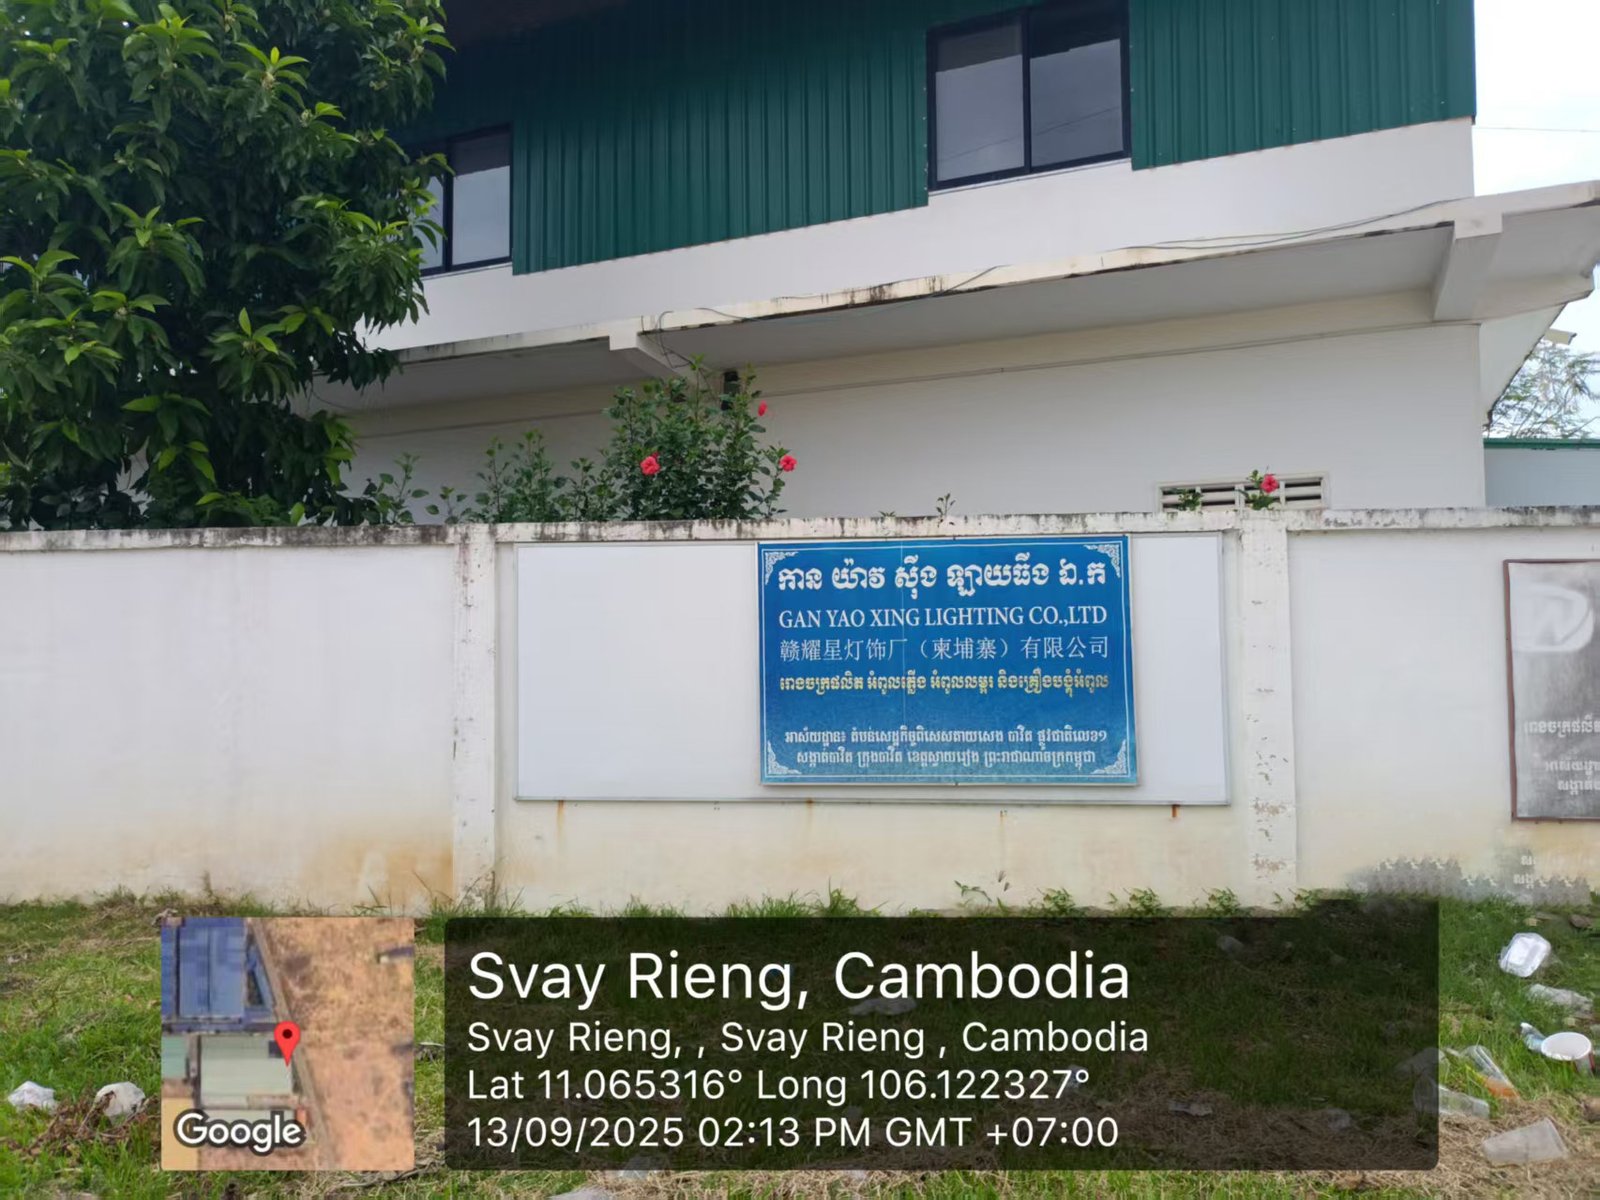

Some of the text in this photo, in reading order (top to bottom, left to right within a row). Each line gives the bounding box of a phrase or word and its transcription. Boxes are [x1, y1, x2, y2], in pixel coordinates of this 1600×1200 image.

[778, 567, 823, 591] កាន
[831, 558, 886, 590] យ៉ាវ
[778, 605, 1107, 628] GAN YAO XING LIGHTING CO.,LTD
